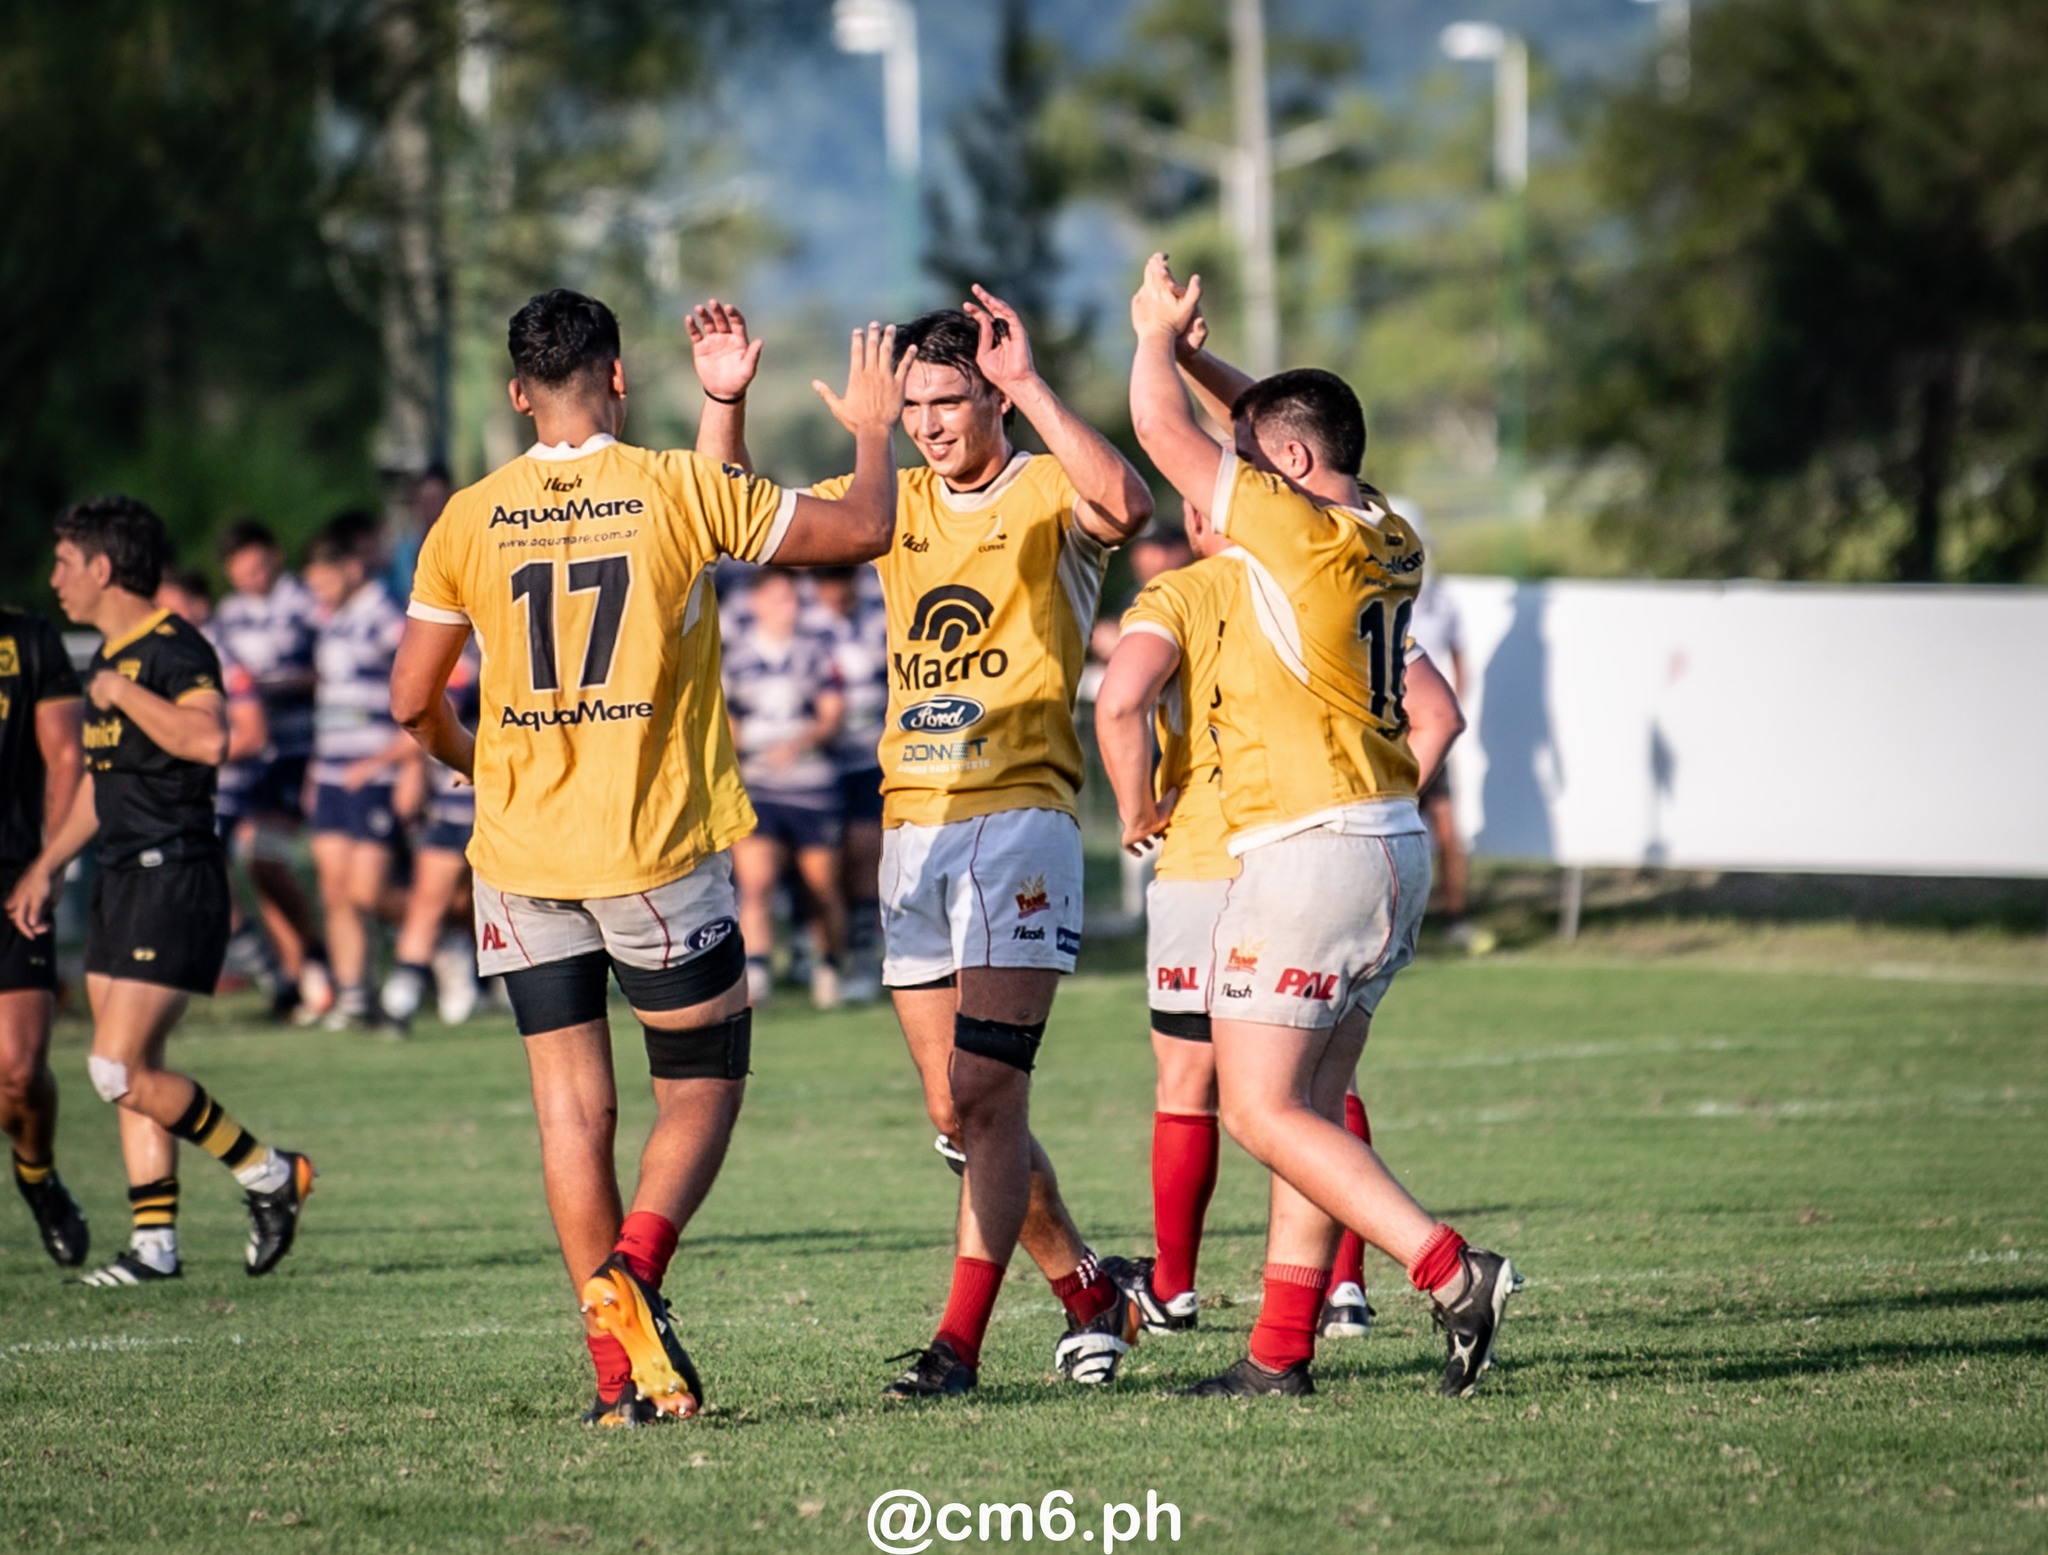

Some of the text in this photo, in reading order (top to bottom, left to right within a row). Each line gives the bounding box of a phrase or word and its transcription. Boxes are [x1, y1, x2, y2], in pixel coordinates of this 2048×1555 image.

[488, 498, 644, 530] AquaMare
[498, 528, 639, 550] www.aquamare.com.ar
[510, 553, 634, 693] 17
[893, 648, 1009, 691] Macro
[501, 699, 654, 732] AquaMare
[910, 700, 967, 728] Ford
[1157, 966, 1200, 991] PAL
[1274, 967, 1339, 1001] PAL
